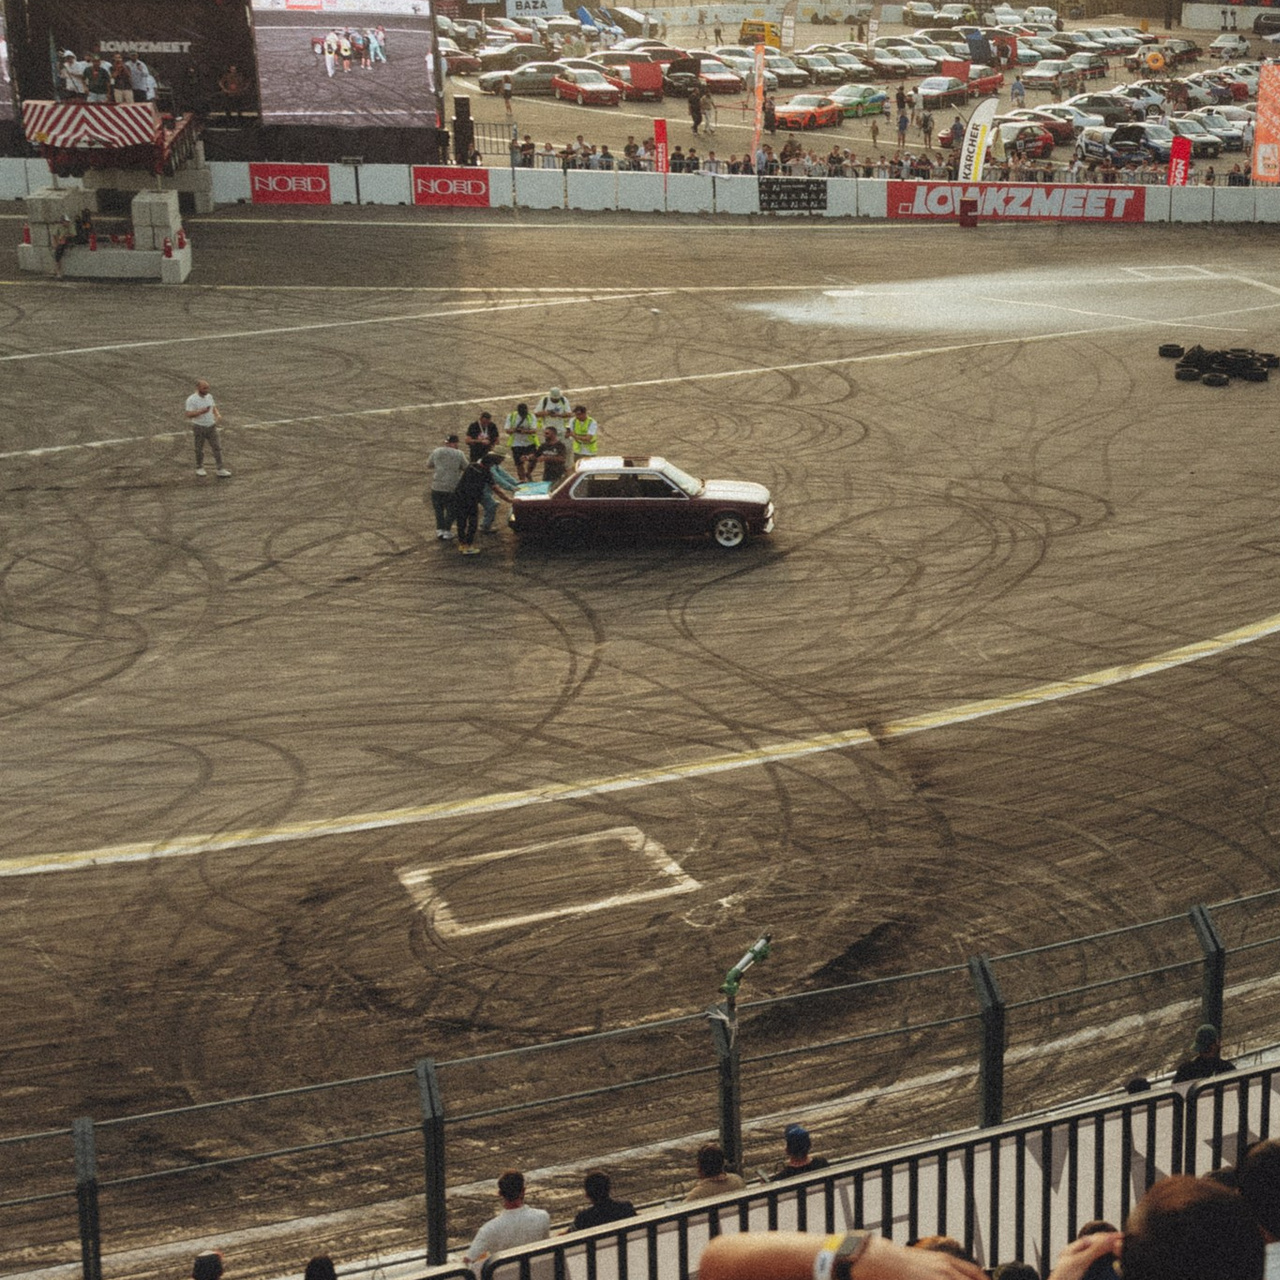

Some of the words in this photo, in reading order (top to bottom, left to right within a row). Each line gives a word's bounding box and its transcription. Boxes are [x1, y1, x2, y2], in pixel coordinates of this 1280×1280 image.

[515, 0, 548, 10] BAZA
[254, 176, 327, 192] NORD
[416, 178, 486, 195] NORD
[914, 185, 1135, 218] LOWKZMEET
